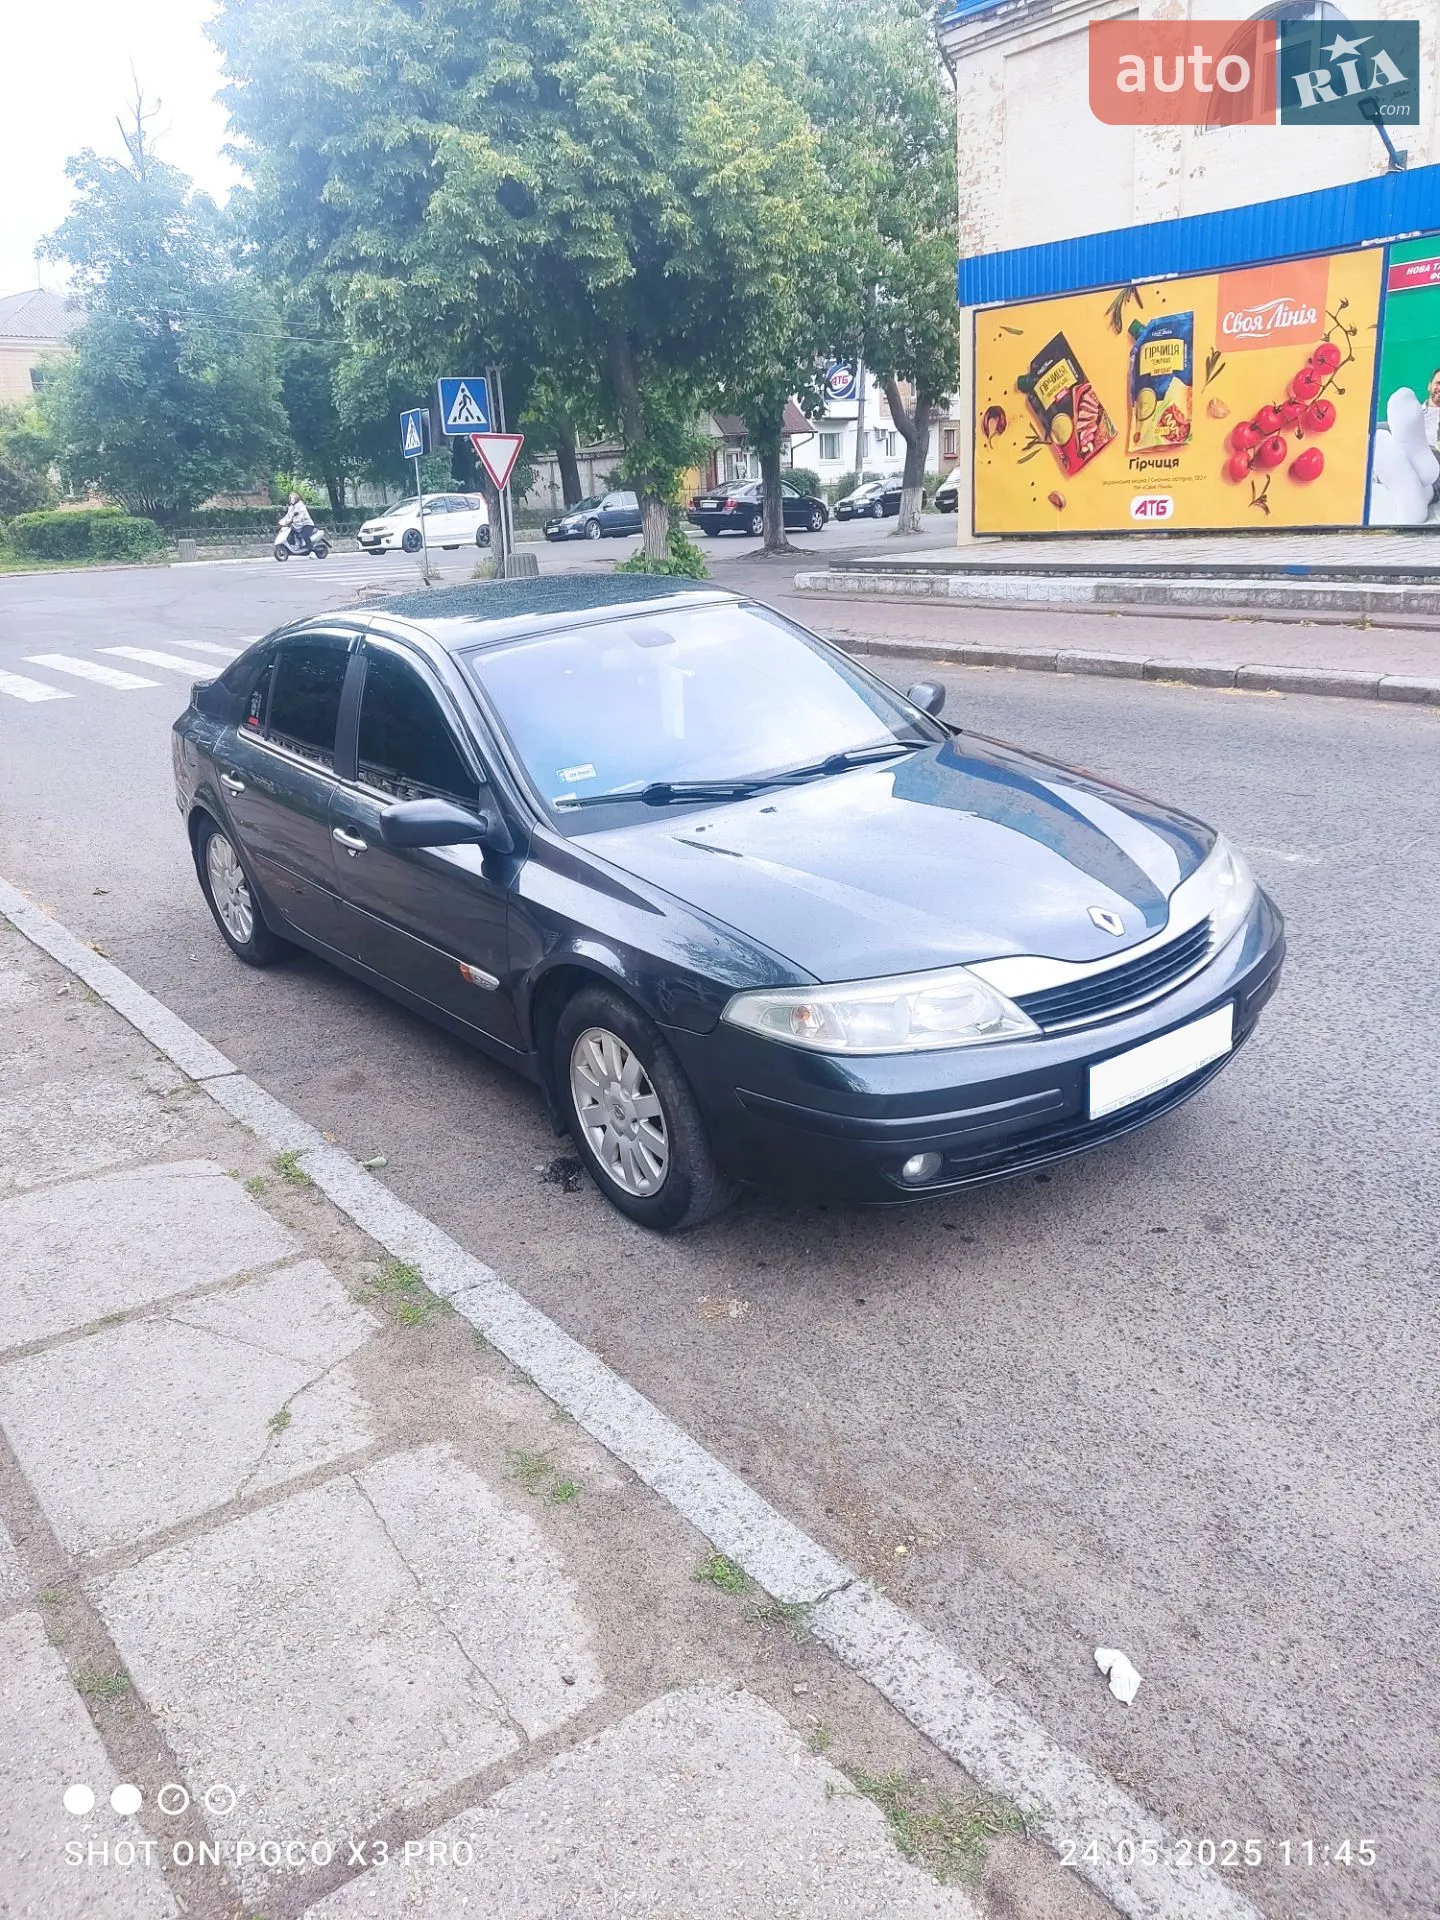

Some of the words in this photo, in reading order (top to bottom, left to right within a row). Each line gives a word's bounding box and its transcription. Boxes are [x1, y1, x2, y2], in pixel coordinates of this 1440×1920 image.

[1406, 264, 1431, 275] НОВА
[1222, 311, 1264, 335] Своя
[1266, 303, 1318, 330] Лінія
[1144, 344, 1180, 360] ГІРЧИЦЯ
[1128, 457, 1180, 471] Гірчиця
[1135, 500, 1169, 516] АТБ
